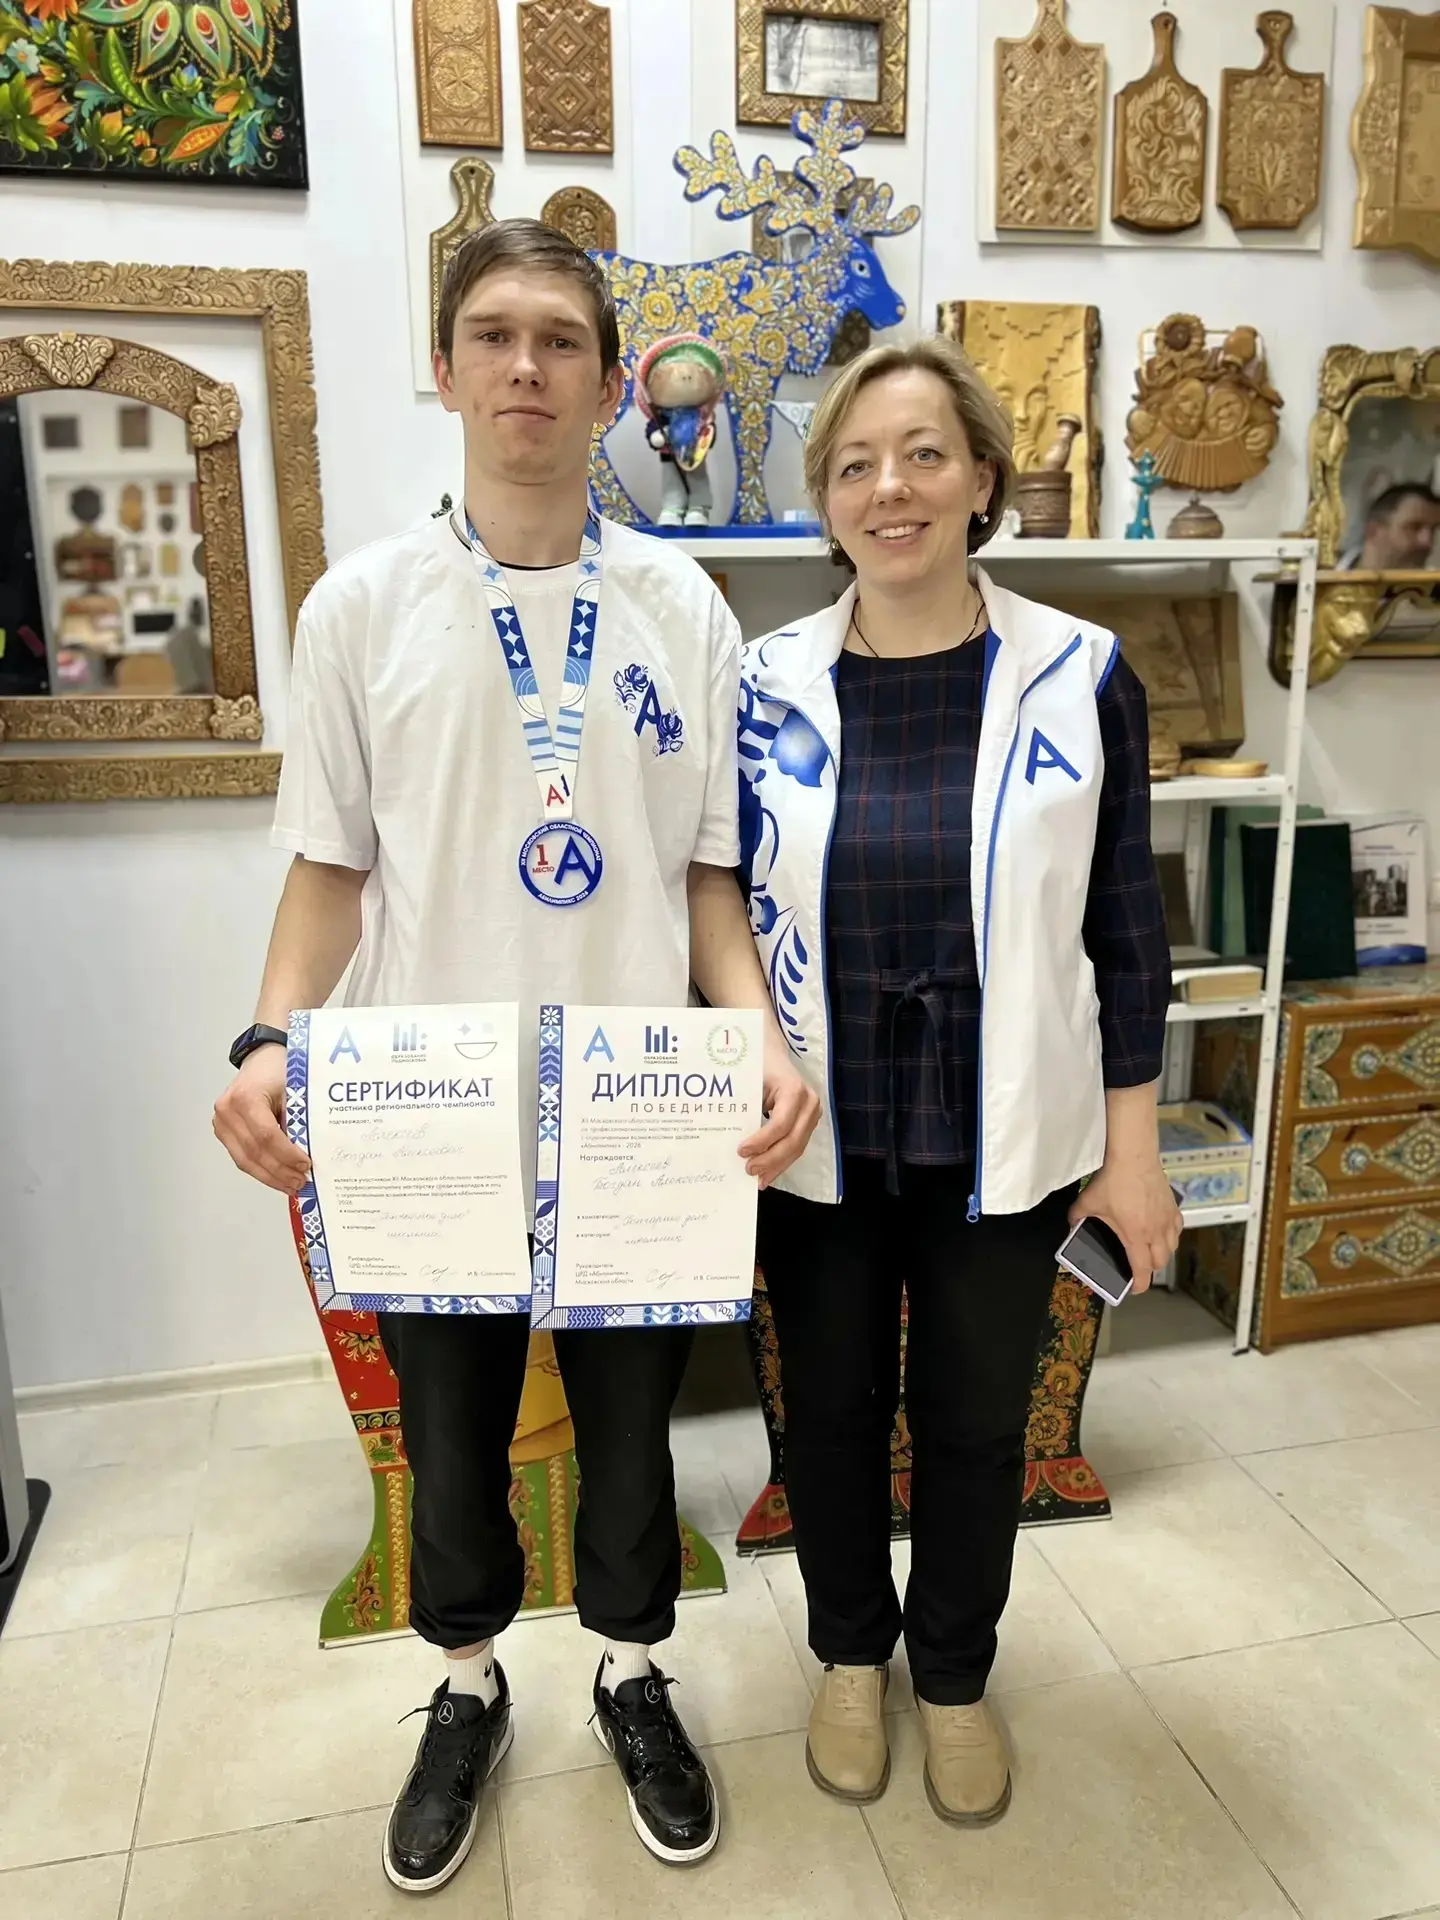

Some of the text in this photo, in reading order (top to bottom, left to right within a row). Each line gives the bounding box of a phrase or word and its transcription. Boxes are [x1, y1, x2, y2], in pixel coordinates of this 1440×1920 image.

[521, 825, 549, 858] МОСКОВСКИЙ
[549, 823, 583, 835] ОБЛАСТНОЙ
[582, 831, 602, 861] ЧЕМПИОНАТ
[536, 844, 549, 866] 1
[537, 890, 589, 904] АБИЛИМПИКС 2026
[723, 1029, 729, 1045] 1
[328, 1077, 494, 1103] СЕРТИФИКАТ
[592, 1073, 733, 1102] ДИПЛОМ
[328, 1100, 495, 1115] участника регионального чемпионата
[630, 1103, 748, 1114] ПОБЕДИТЕЛЯ
[592, 1169, 727, 1196] Богдан Алексеевич
[497, 1297, 517, 1313] 2026
[717, 1303, 734, 1321] 2026
